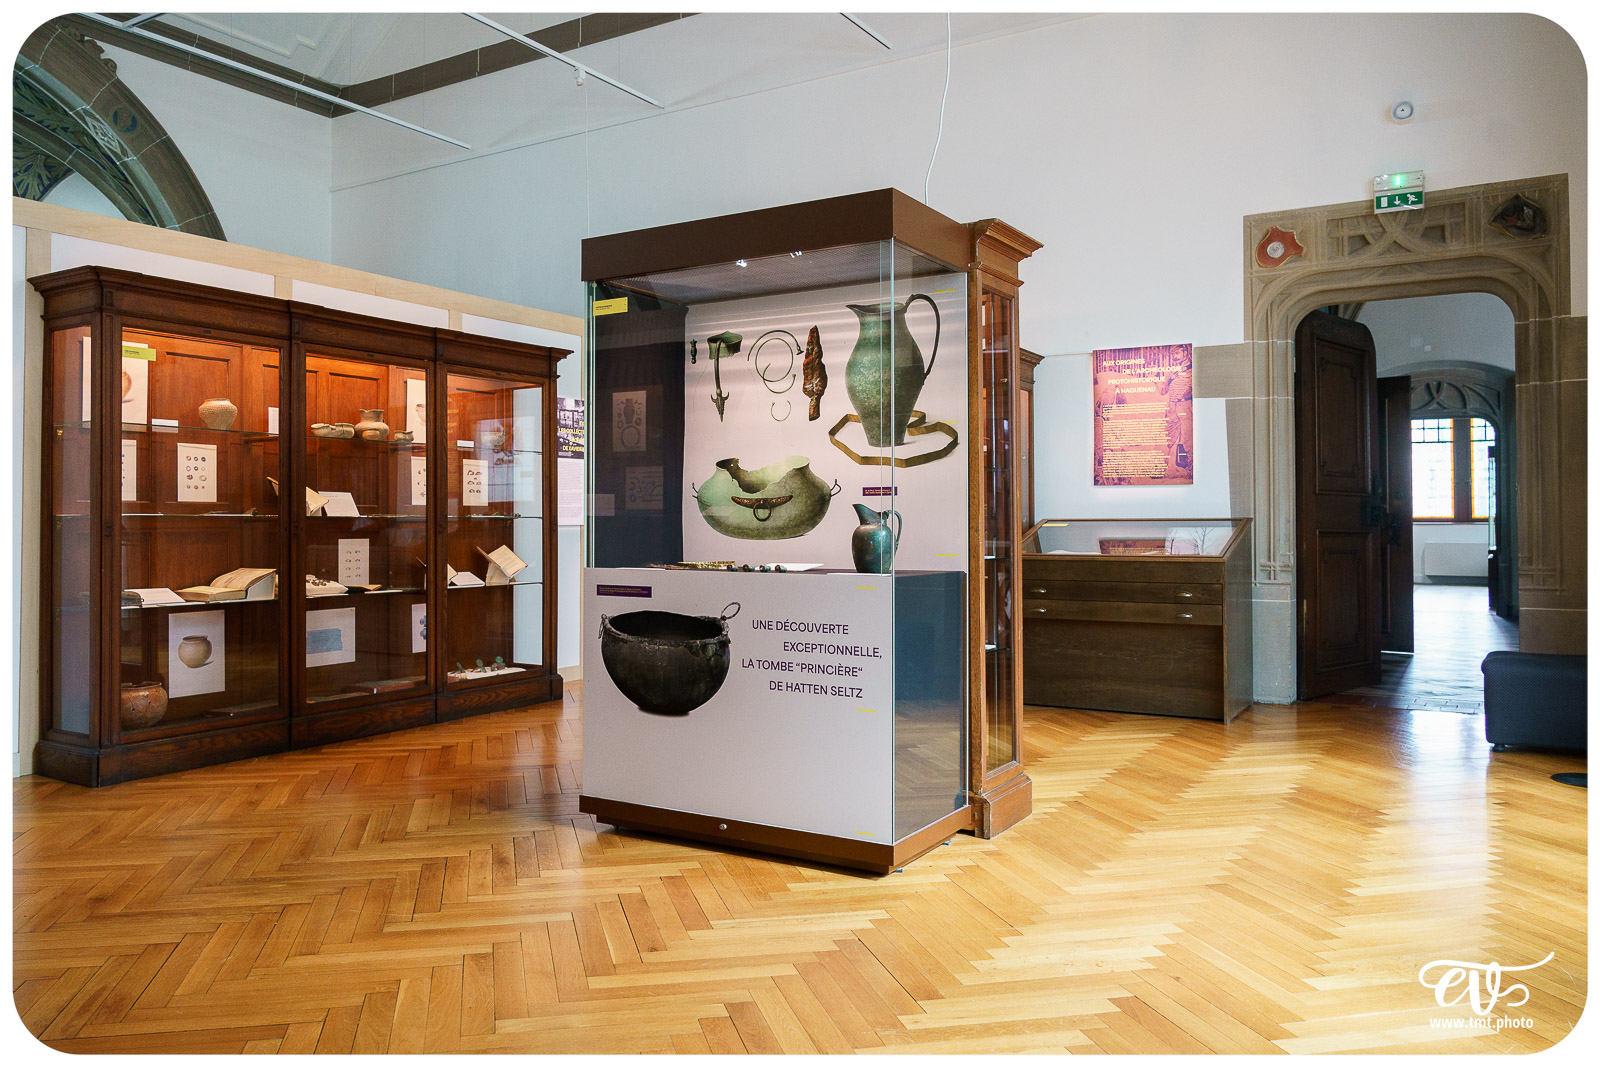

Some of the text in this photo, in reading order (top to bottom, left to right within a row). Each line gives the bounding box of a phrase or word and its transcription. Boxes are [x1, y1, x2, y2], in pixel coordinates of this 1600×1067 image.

[1115, 358, 1145, 366] ORIGINES
[1108, 376, 1166, 385] PROTOHISTORIQUE
[752, 618, 849, 635] UNE DÉCOUVERTE
[783, 641, 882, 660] EXCEPTIONNELLE,
[756, 659, 794, 672] TOMBE
[769, 680, 863, 699] DE HATTEN SELTZ
